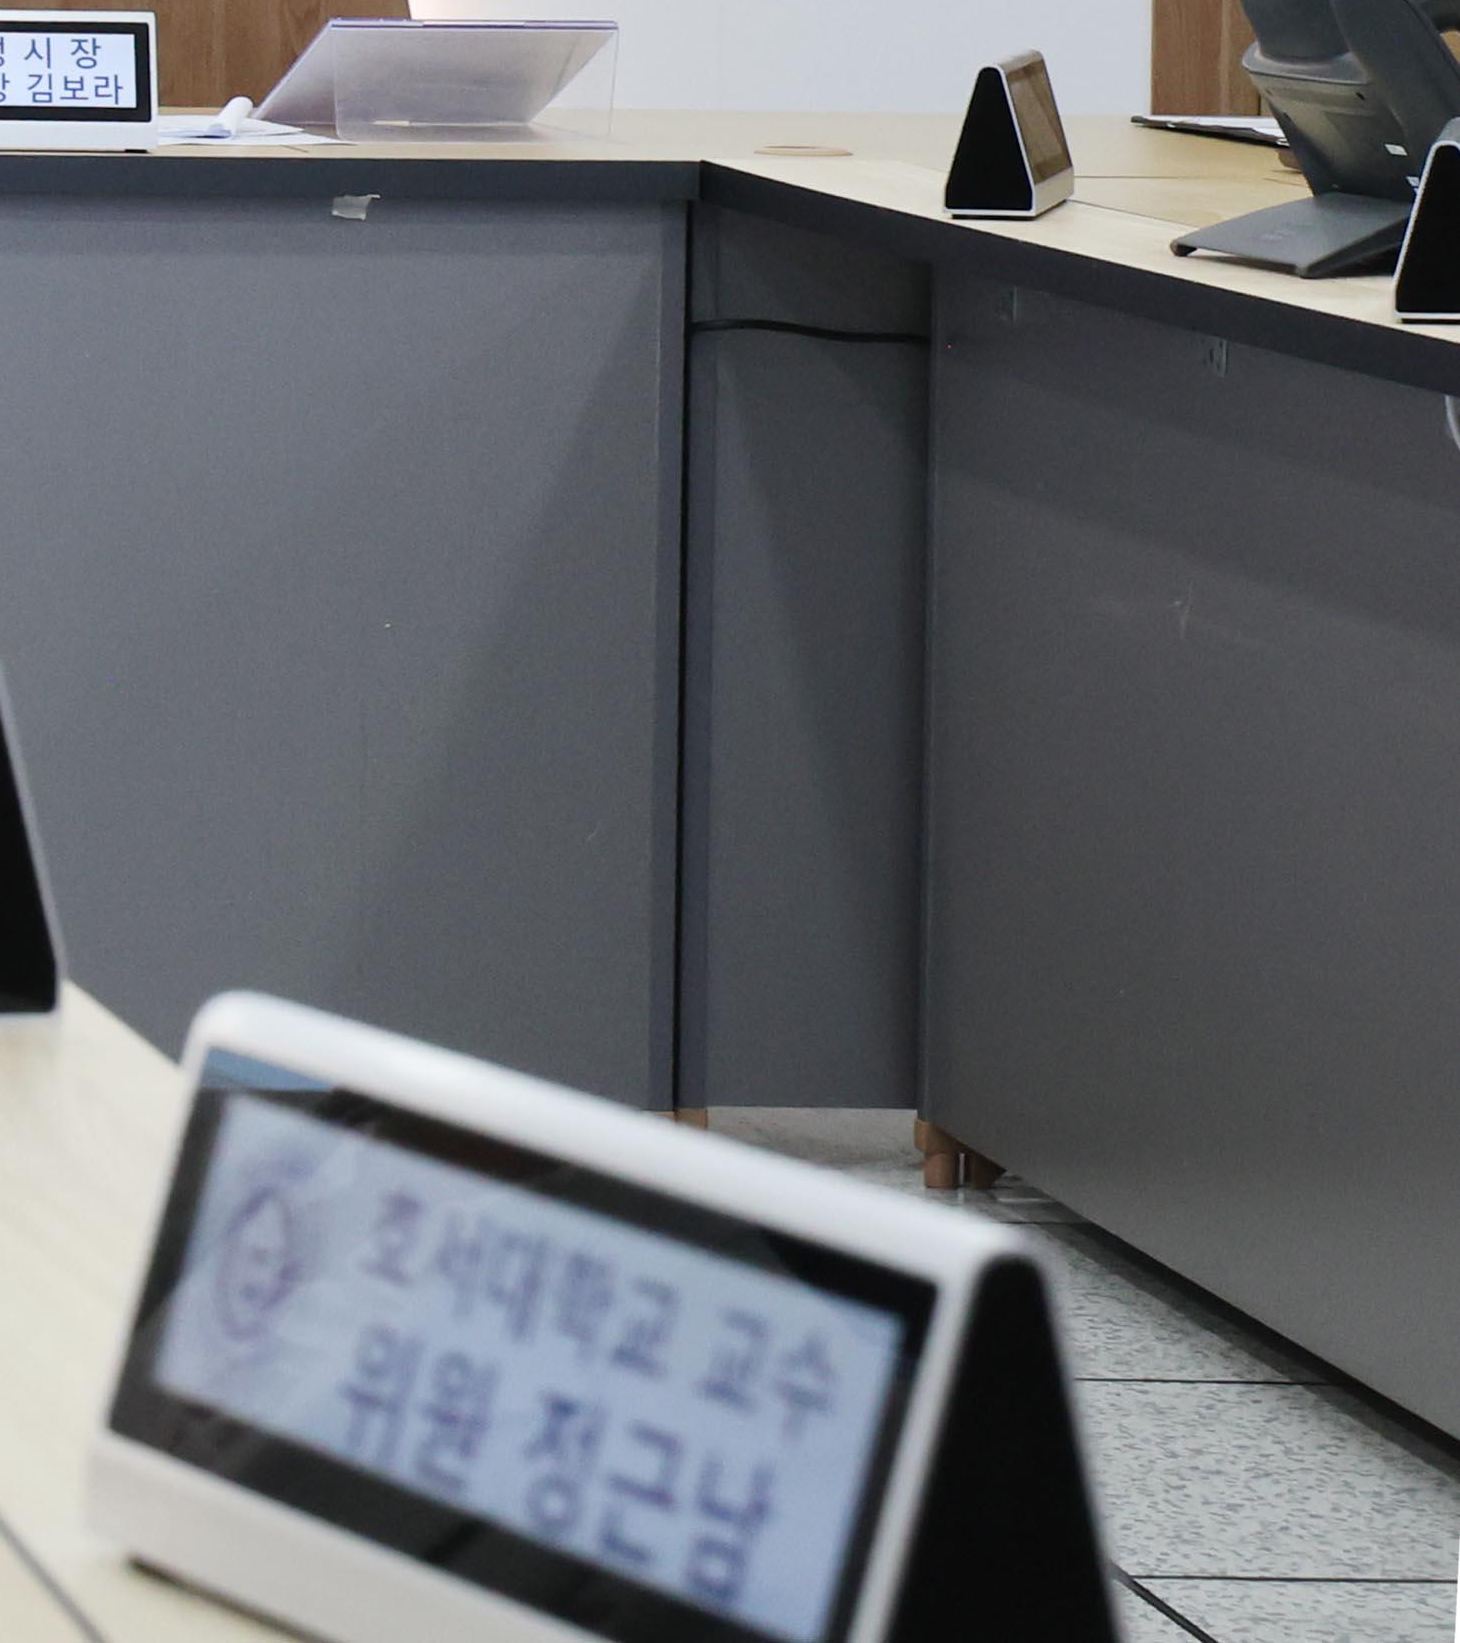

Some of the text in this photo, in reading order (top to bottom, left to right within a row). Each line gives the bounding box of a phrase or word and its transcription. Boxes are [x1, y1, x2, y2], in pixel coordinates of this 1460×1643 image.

[27, 73, 124, 105] 김보라
[696, 1305, 841, 1441] 교수
[338, 1325, 775, 1607] 위원 정근남
